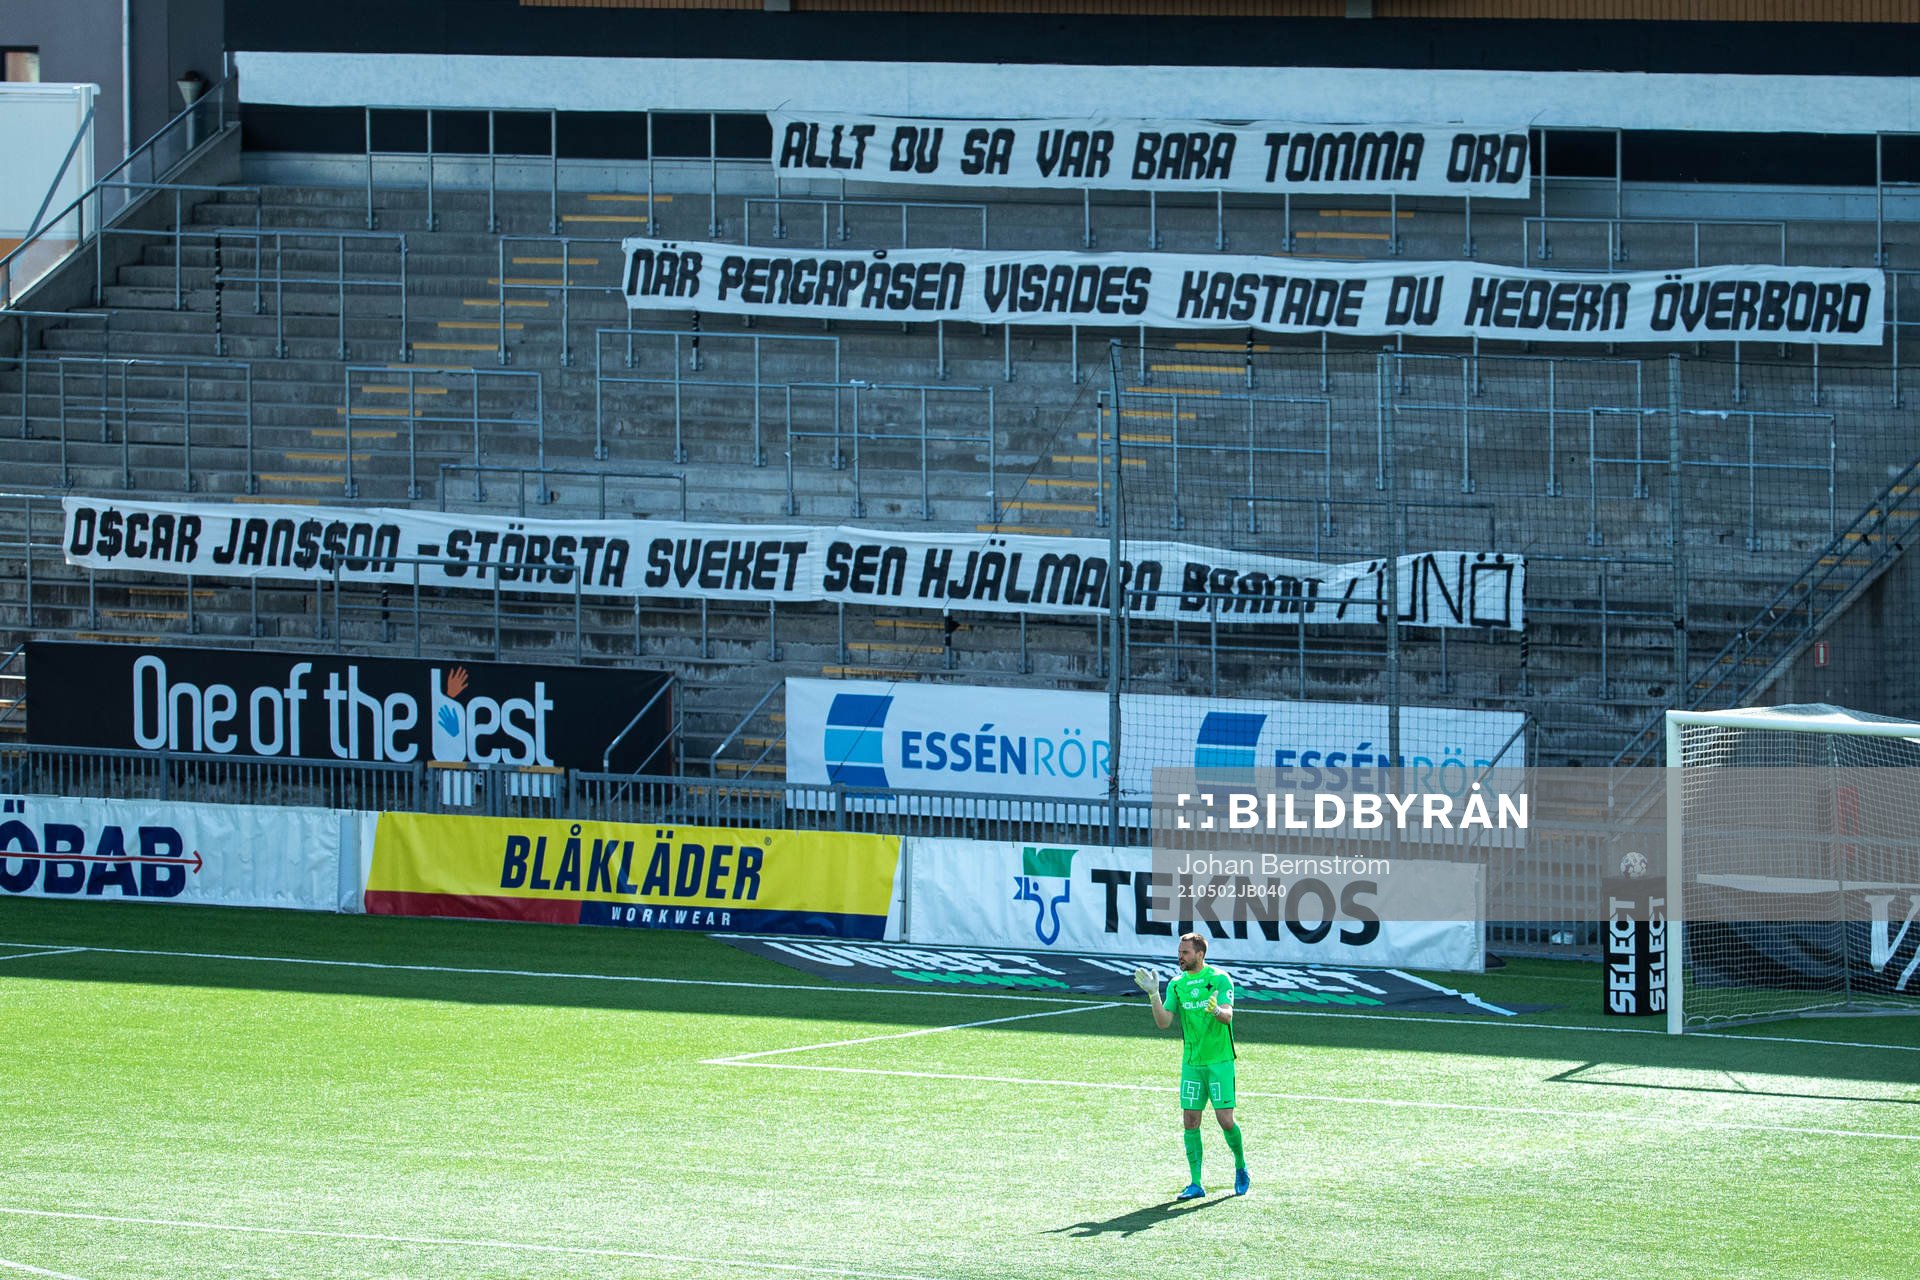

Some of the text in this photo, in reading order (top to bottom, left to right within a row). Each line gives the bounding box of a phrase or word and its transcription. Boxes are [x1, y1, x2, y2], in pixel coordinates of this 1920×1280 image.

[779, 121, 1528, 184] ALLT DU SA VAR BARA TOMMA ORD
[626, 242, 1872, 333] NÄR PENGAPÅSEN VISADES KASTADE DU HEDERN ÖVERBORD
[69, 506, 201, 563] O$CAR
[645, 537, 808, 592] SVEKET
[823, 541, 907, 596] SEN
[133, 655, 553, 767] One of the best
[500, 823, 764, 900] BLÅKLÄDER
[611, 906, 732, 926] WORKWEAR
[1091, 868, 1380, 946] TEKNOS
[1609, 896, 1636, 1014] SELECT
[1649, 896, 1665, 1013] SELECT
